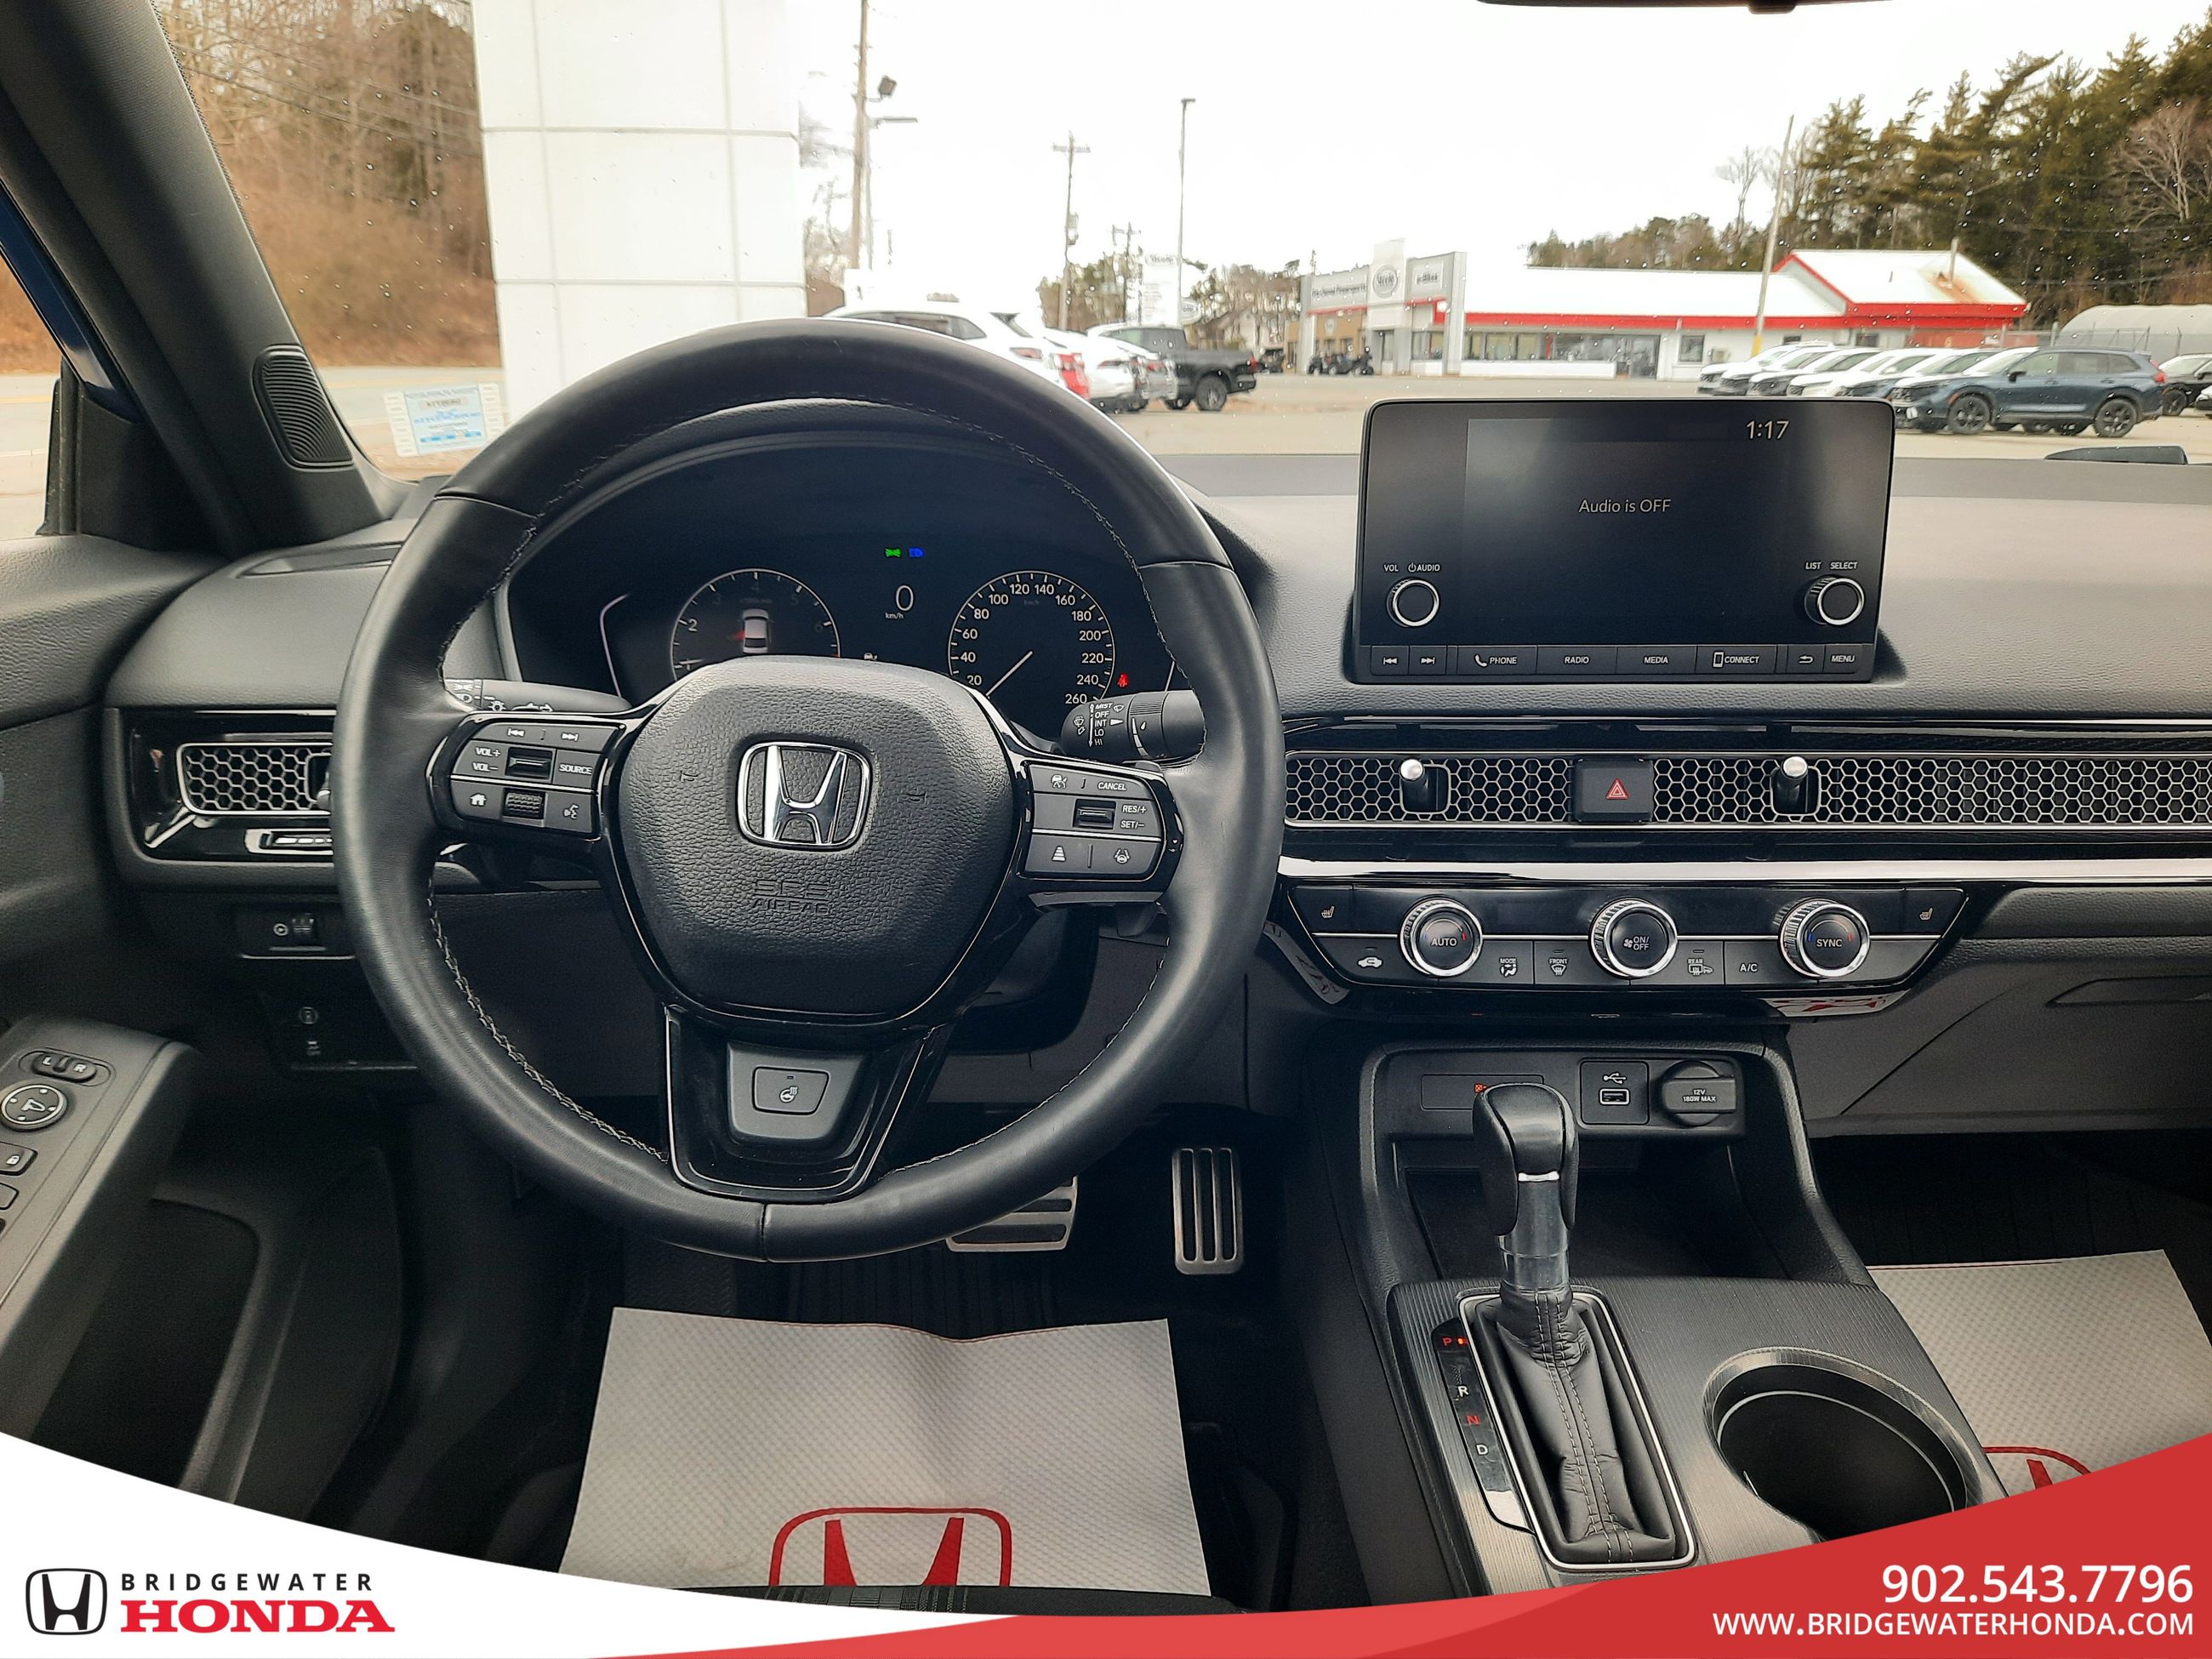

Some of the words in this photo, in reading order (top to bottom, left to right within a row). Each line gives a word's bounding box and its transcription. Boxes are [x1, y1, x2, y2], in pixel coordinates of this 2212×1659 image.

[1746, 420, 1789, 439] 1:17
[1578, 499, 1621, 513] Audio
[1625, 499, 1636, 513] is
[1639, 499, 1672, 512] OFF
[1805, 562, 1821, 570] LIST
[1830, 562, 1858, 570] SELECT
[1009, 584, 1029, 595] 120
[1035, 584, 1054, 596] 140
[896, 584, 914, 611] 0
[988, 594, 1008, 605] 100
[1055, 595, 1075, 605] 160
[973, 608, 989, 619] 80
[1071, 610, 1092, 621] 180
[688, 618, 698, 631] 2
[962, 628, 978, 639] 60
[1079, 630, 1101, 641] 200
[960, 652, 976, 662] 40
[1081, 653, 1103, 664] 220
[1489, 656, 1518, 664] PHONE
[1564, 656, 1589, 664] RADIO
[1644, 656, 1668, 664] MEDIA
[966, 675, 982, 686] 20
[1076, 675, 1099, 686] 240
[1064, 693, 1087, 704] 260
[559, 764, 593, 775] SOURCE
[1097, 782, 1127, 791] CANCEL
[1431, 938, 1457, 947] AUTO
[1816, 938, 1843, 948] SYNC
[1740, 964, 1758, 972] A/C
[1442, 1337, 1451, 1346] P
[1457, 1386, 1469, 1397] R
[1476, 1444, 1488, 1455] D
